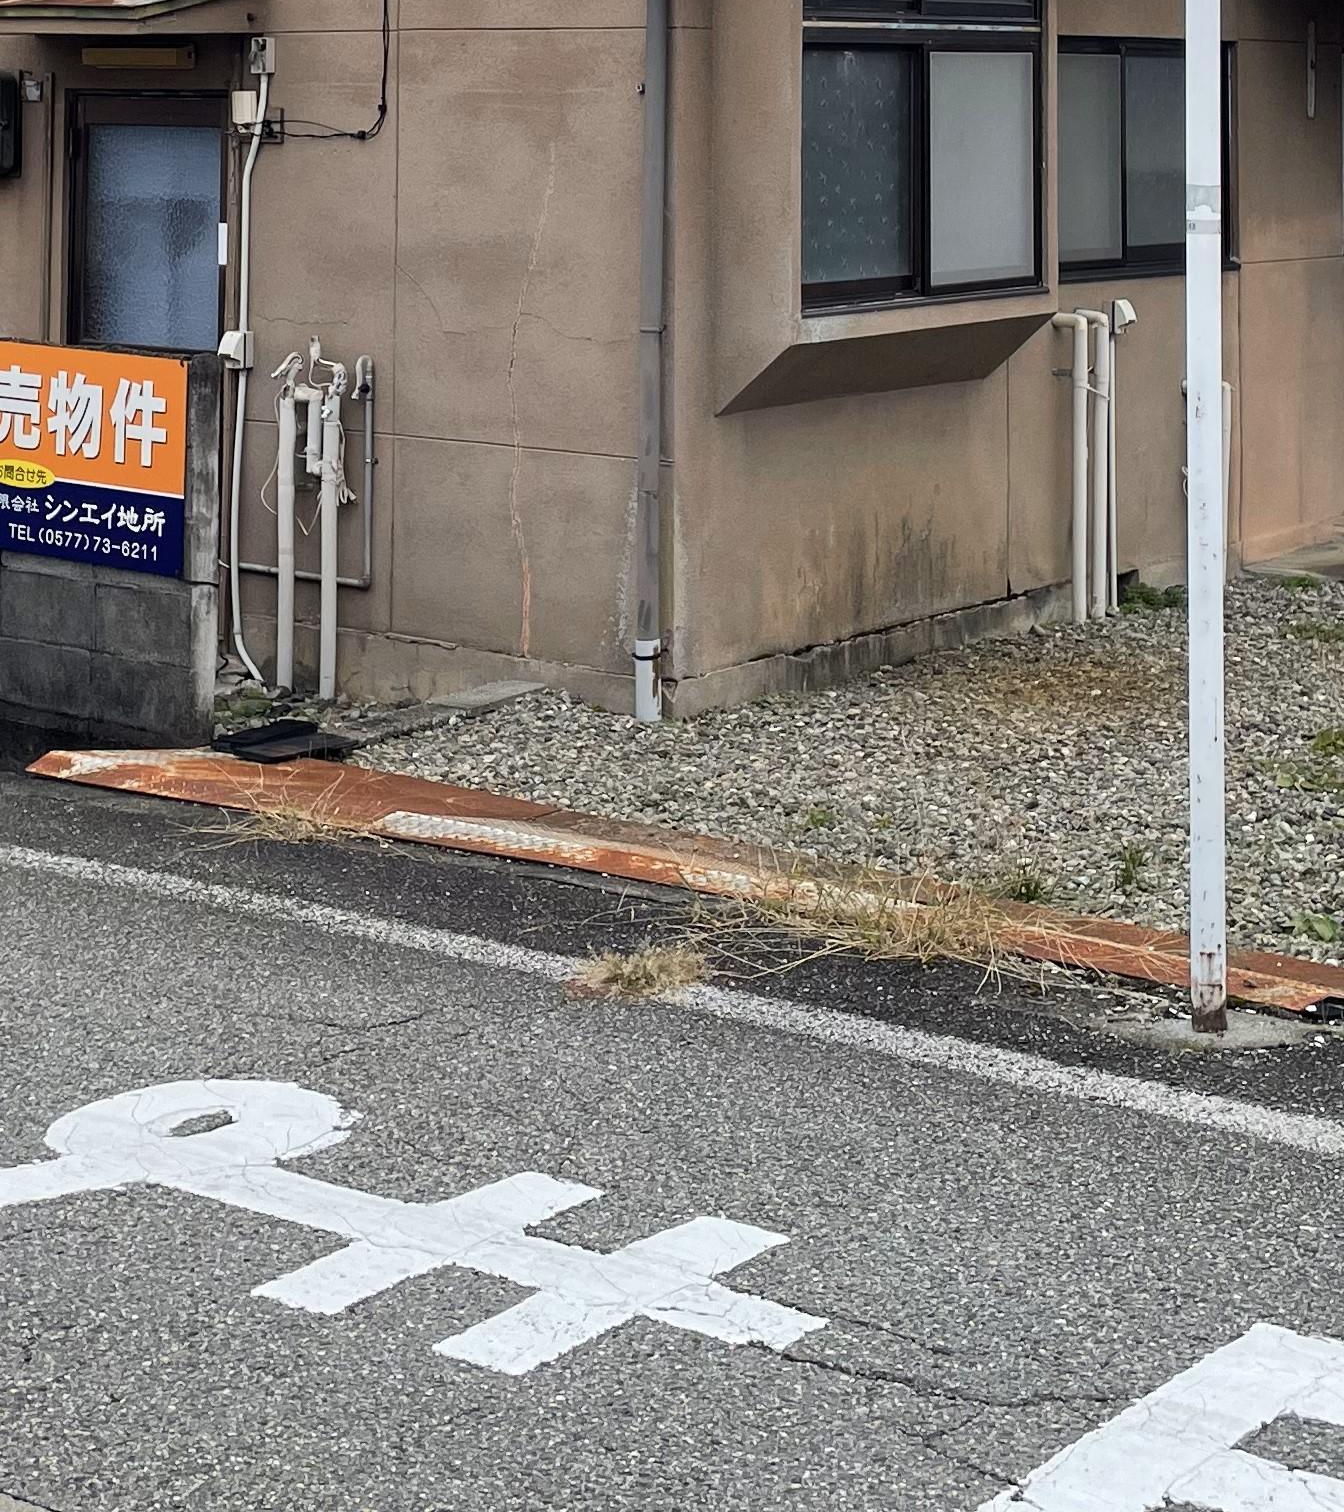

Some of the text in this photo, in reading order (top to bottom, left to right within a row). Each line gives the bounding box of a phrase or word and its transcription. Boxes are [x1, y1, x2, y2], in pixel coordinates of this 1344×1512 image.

[44, 494, 166, 538] シンエイ地所
